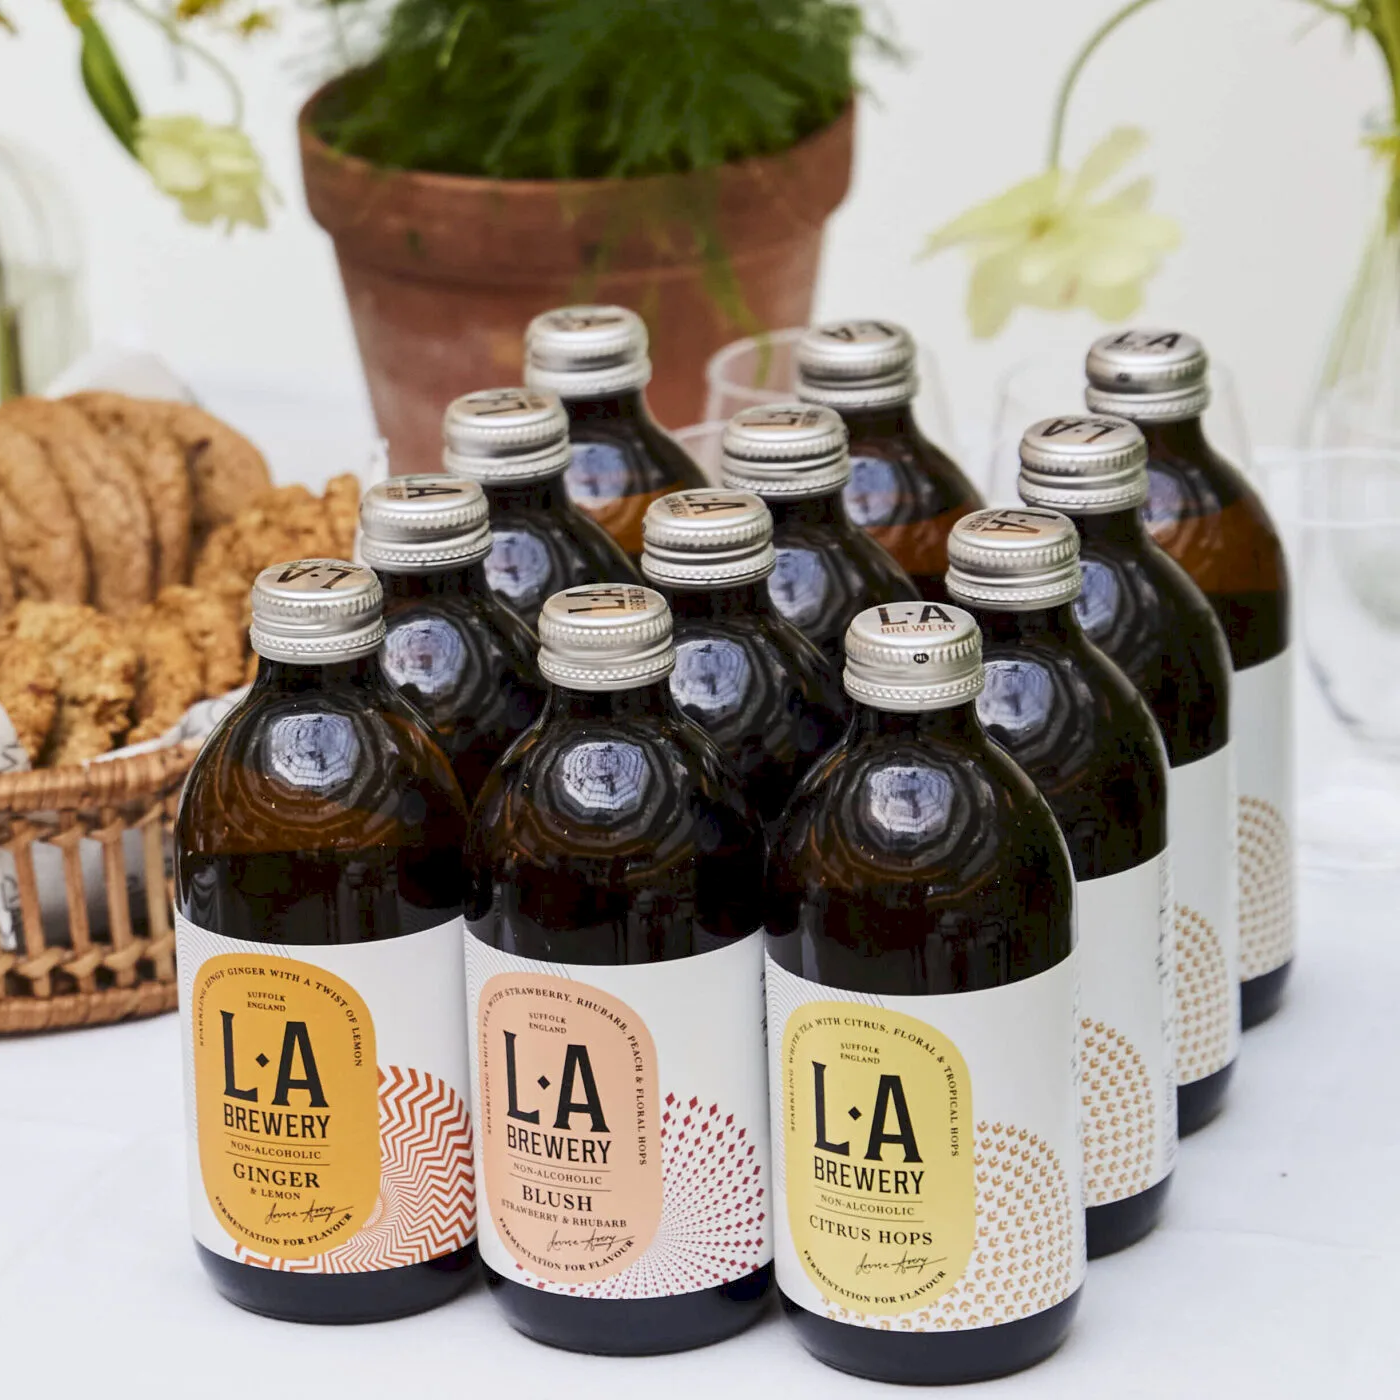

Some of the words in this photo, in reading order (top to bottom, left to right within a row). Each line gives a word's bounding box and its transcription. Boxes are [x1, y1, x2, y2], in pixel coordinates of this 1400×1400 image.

[880, 622, 957, 635] BREWERY
[227, 967, 266, 976] GINGER
[269, 968, 300, 982] WITH
[303, 978, 312, 986] A
[247, 991, 286, 1002] SUFFOLK
[315, 982, 348, 1008] TWIST
[487, 990, 505, 1008] WITH
[504, 986, 573, 1004] STRAWBERRY,
[247, 1001, 287, 1013] ENGLAND
[345, 1008, 358, 1025] OF
[528, 1011, 567, 1024] SUFFOLK
[576, 996, 629, 1035] RHUBARB,
[528, 1021, 567, 1035] ENGLAND
[798, 1021, 815, 1038] TEA
[814, 1016, 841, 1027] WITH
[843, 1017, 890, 1035] CITRUS,
[351, 1026, 364, 1067] LEMON
[627, 1034, 644, 1072] PEACH
[788, 1031, 801, 1064] WHITE
[840, 1042, 880, 1055] SUFFOLK
[893, 1027, 937, 1056] FLORAL
[840, 1052, 881, 1065] ENGLAND
[936, 1055, 945, 1064] &
[634, 1075, 643, 1084] &
[943, 1065, 959, 1125] TROPICAL
[223, 1103, 331, 1139] BREWERY
[636, 1087, 646, 1132] FLORAL
[230, 1140, 322, 1160] NON-ALCOHOLIC
[506, 1123, 612, 1165] BREWERY
[637, 1136, 648, 1166] HOPS
[950, 1127, 960, 1158] HOPS
[233, 1162, 321, 1188] GINGER
[513, 1162, 603, 1186] NON-ALCOHOLIC
[813, 1155, 925, 1195] BREWERY
[250, 1187, 257, 1196] &
[261, 1188, 301, 1201] LEMON
[521, 1184, 593, 1212] BLUSH
[820, 1194, 915, 1216] NON-ALCOHOLIC
[215, 1195, 280, 1246] FERMENTATION
[283, 1237, 306, 1247] FOR
[308, 1212, 354, 1244] FLAVOUR
[501, 1198, 559, 1222] STRAWBERRY
[561, 1217, 570, 1225] &
[572, 1218, 628, 1229] RHUBARB
[809, 1214, 871, 1242] CITRUS
[878, 1230, 933, 1246] HOPS
[499, 1217, 562, 1272] FERMENTATION
[564, 1262, 587, 1272] FOR
[588, 1239, 635, 1270] FLAVOUR
[803, 1249, 872, 1304] FERMENTATION
[874, 1294, 897, 1305] FOR
[899, 1269, 948, 1302] FLAVOUR
